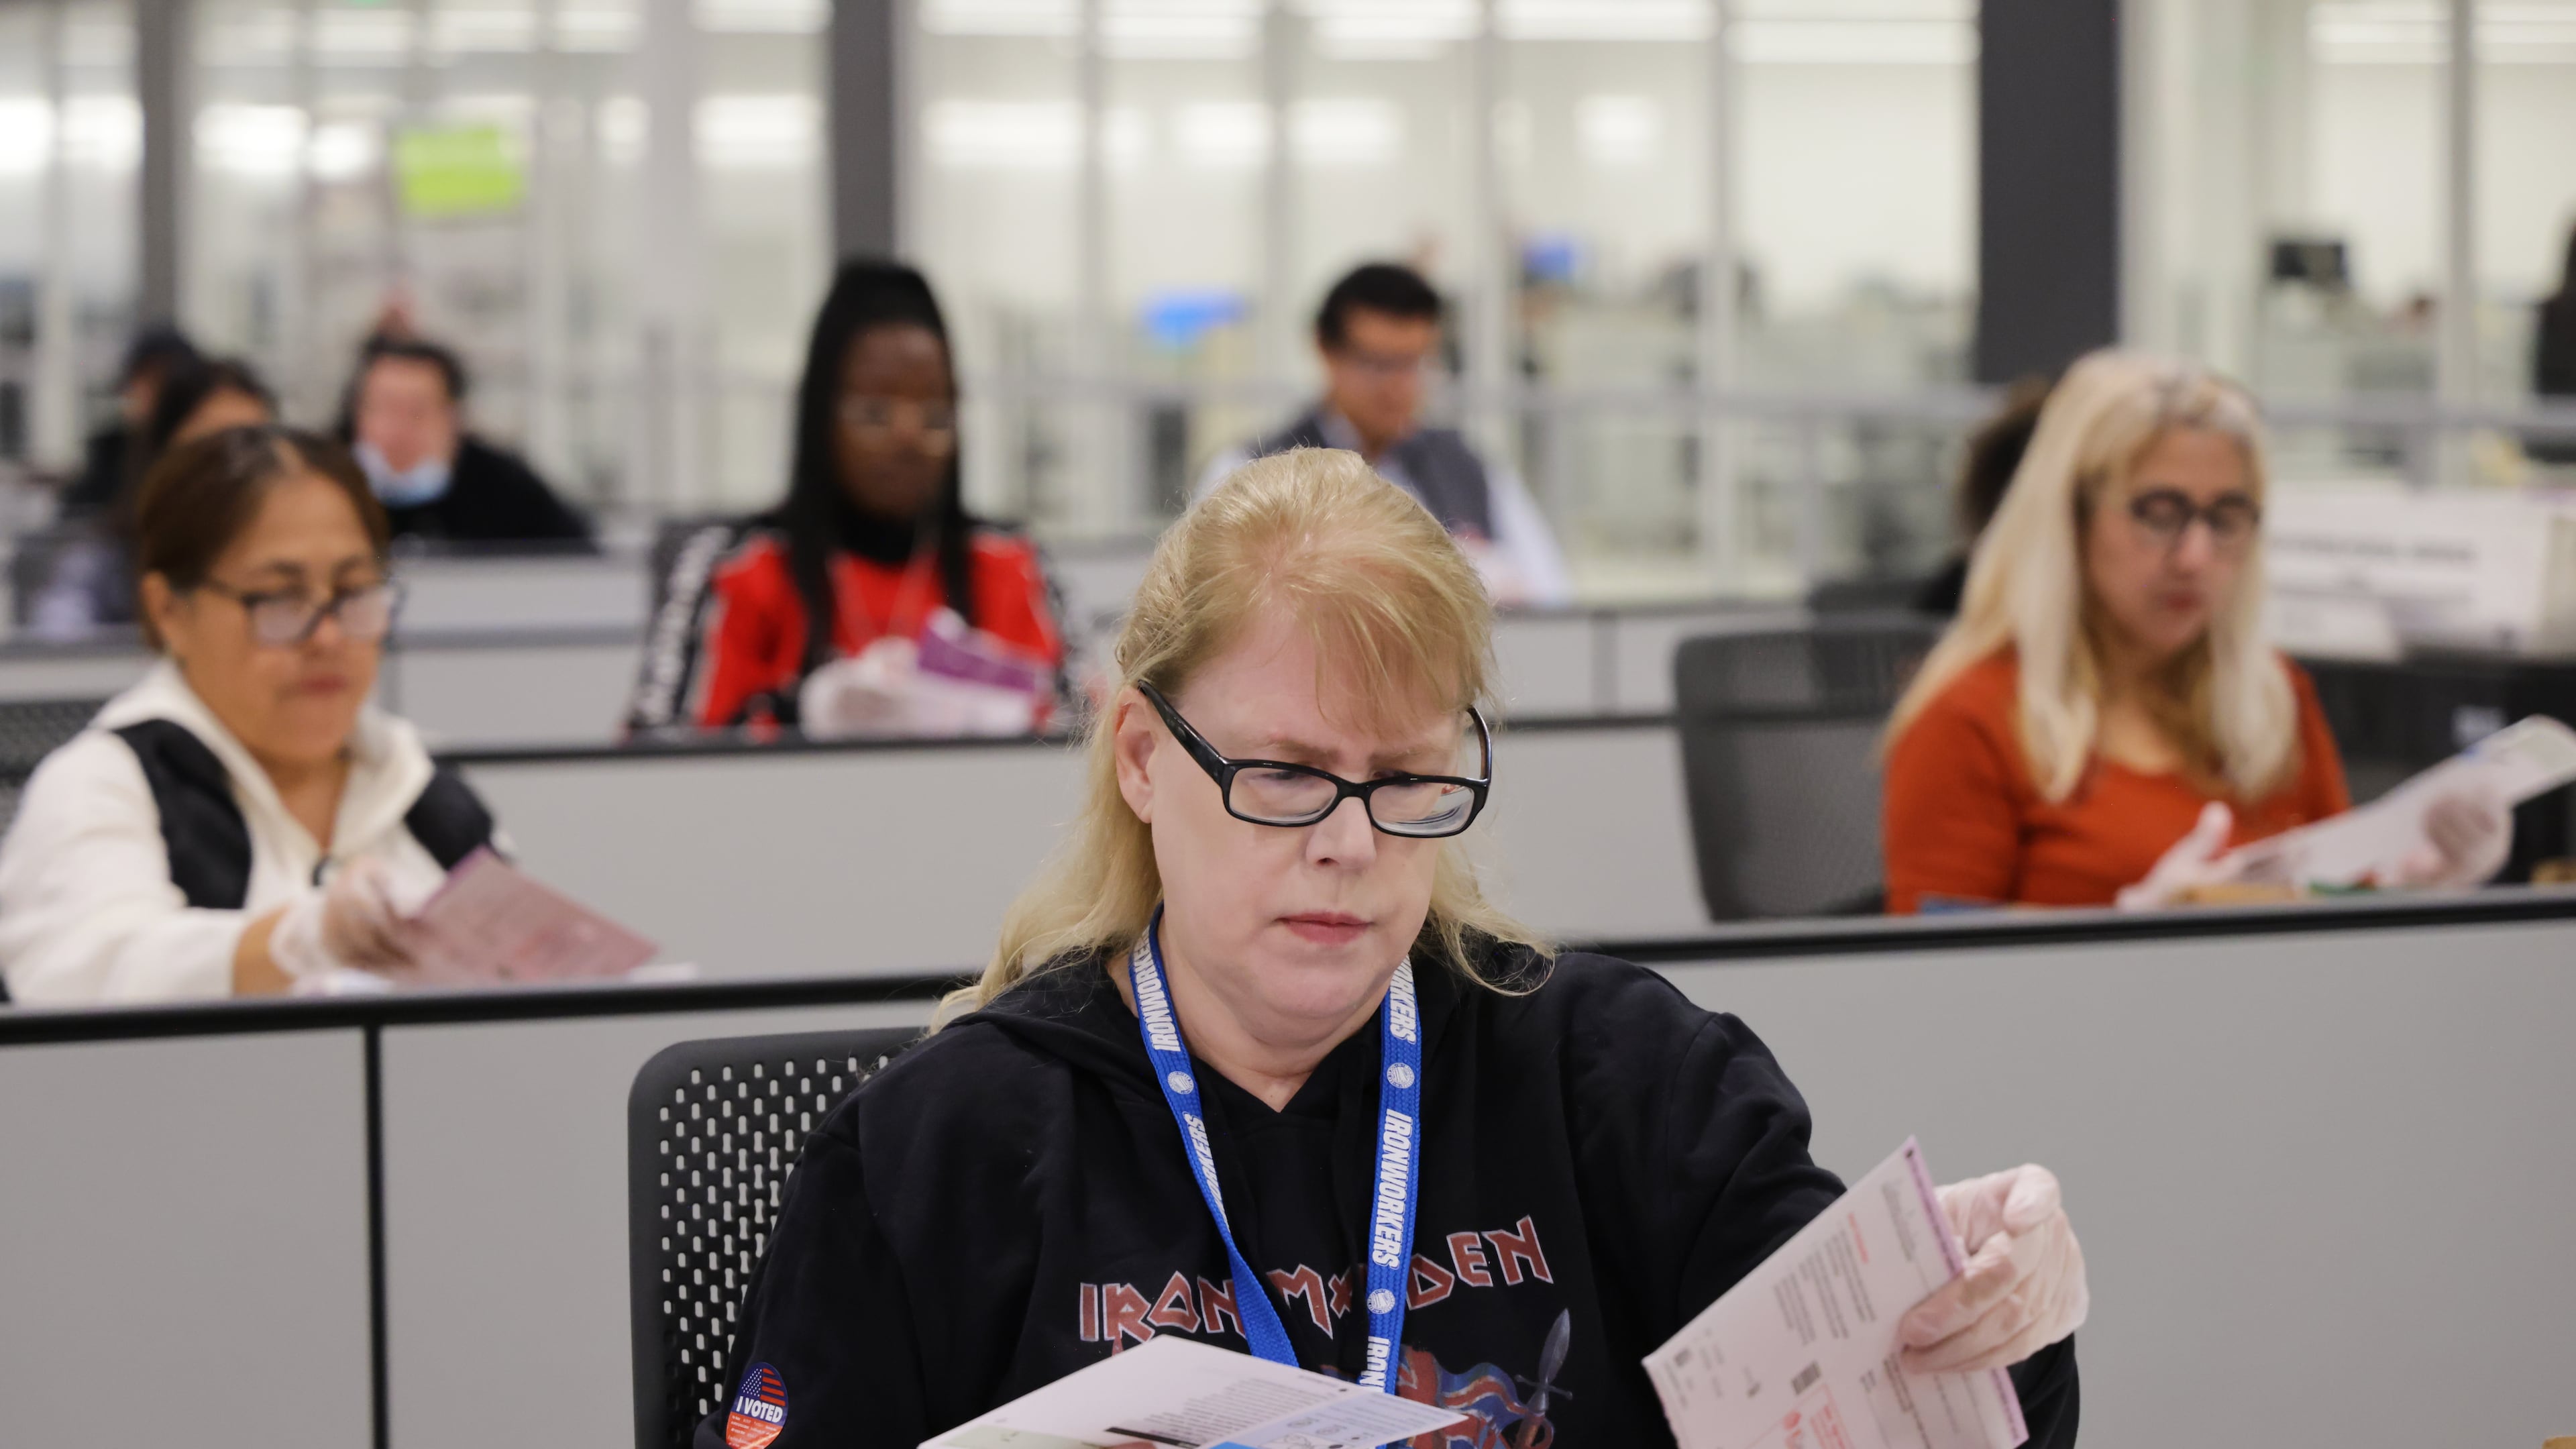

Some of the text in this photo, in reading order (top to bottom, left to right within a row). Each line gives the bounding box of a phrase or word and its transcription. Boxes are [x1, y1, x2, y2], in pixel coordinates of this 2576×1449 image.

[1134, 924, 1181, 1052] IRONWORKE
[1373, 1108, 1412, 1270] IRONWORKERS
[1079, 1215, 1554, 1342] IRON MDEN
[736, 1395, 784, 1423] I VOTED
[1360, 1336, 1391, 1393] IRON
